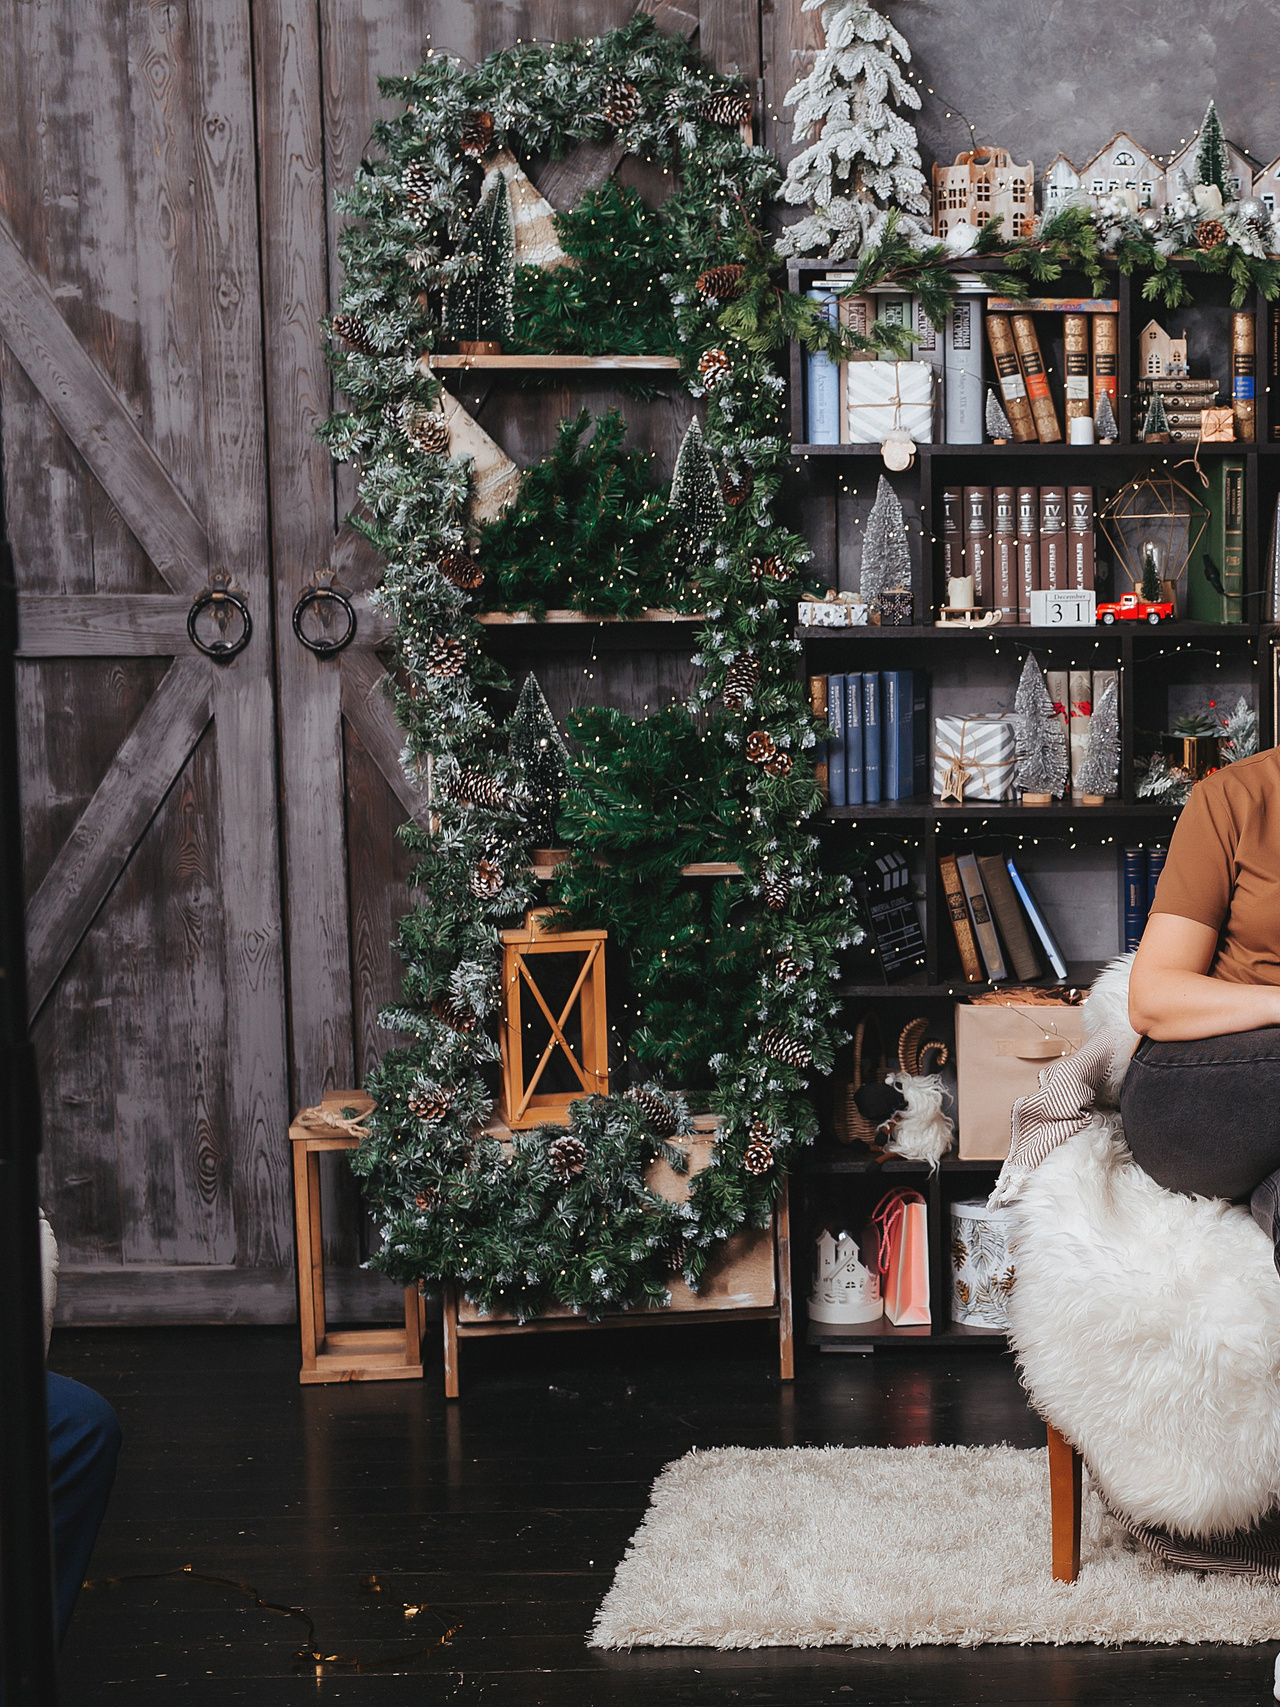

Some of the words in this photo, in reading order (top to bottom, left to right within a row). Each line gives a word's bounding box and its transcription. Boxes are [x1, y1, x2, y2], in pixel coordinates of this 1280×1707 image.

[953, 305, 963, 347] ИСТОРИЯ
[962, 305, 970, 347] ВСЕМИРНАЯ
[1044, 504, 1061, 516] IV
[1073, 504, 1088, 516] IV
